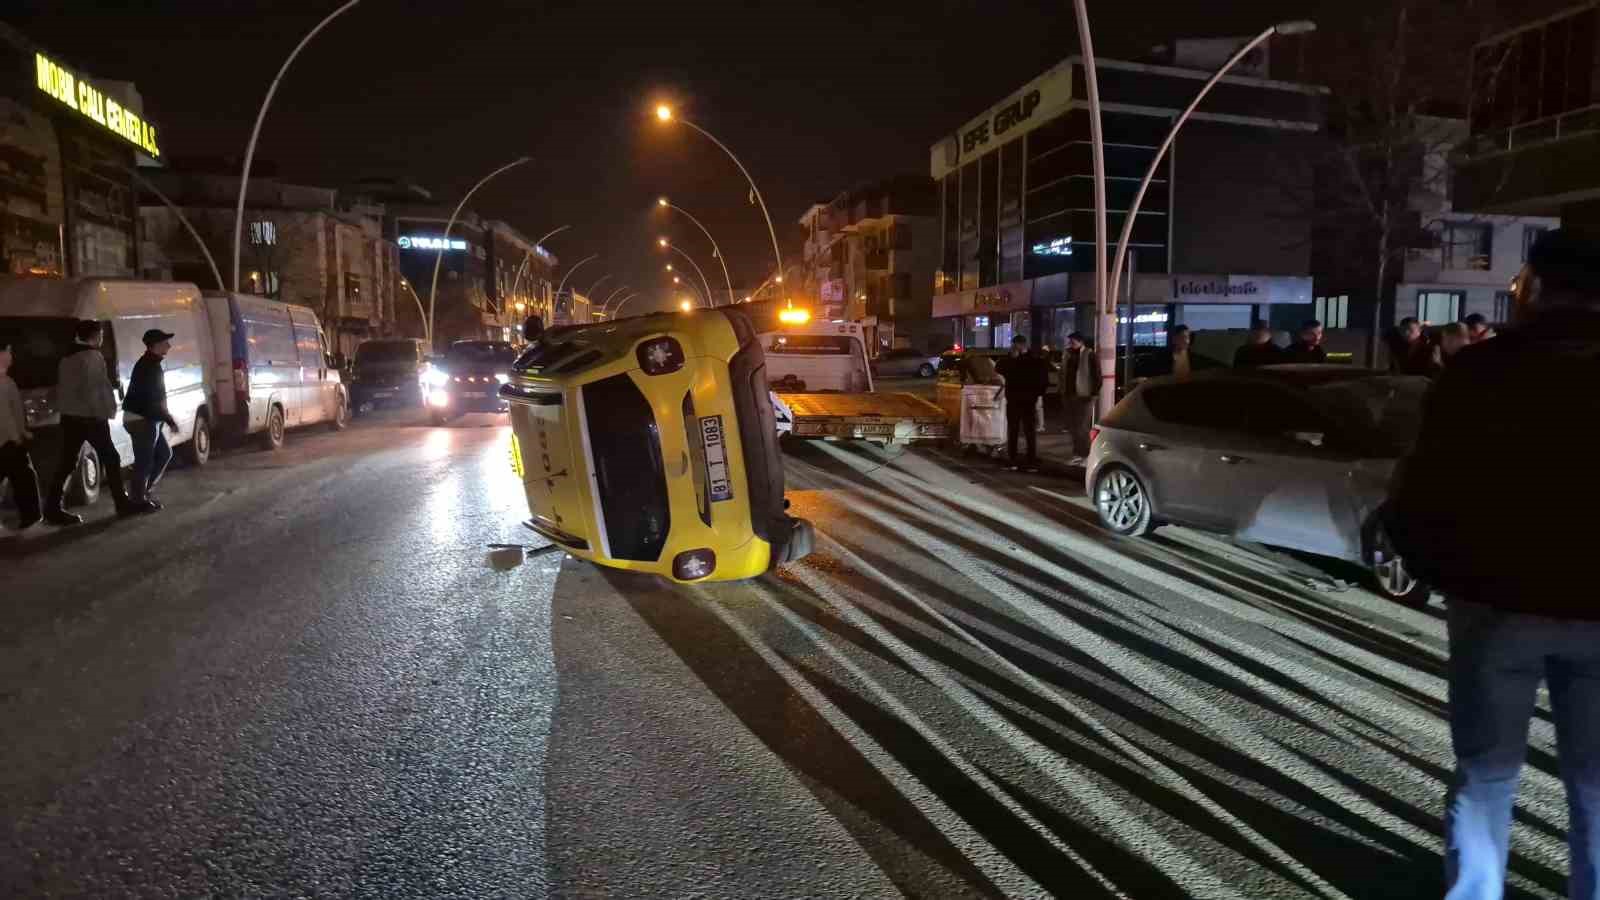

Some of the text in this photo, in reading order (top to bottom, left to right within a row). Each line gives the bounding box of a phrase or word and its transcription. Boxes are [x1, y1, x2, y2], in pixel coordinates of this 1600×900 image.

[78, 81, 106, 126] CALL
[106, 98, 142, 146] CENTER
[993, 89, 1040, 136] GRUP
[704, 418, 720, 448] 1083
[712, 478, 726, 492] 81
